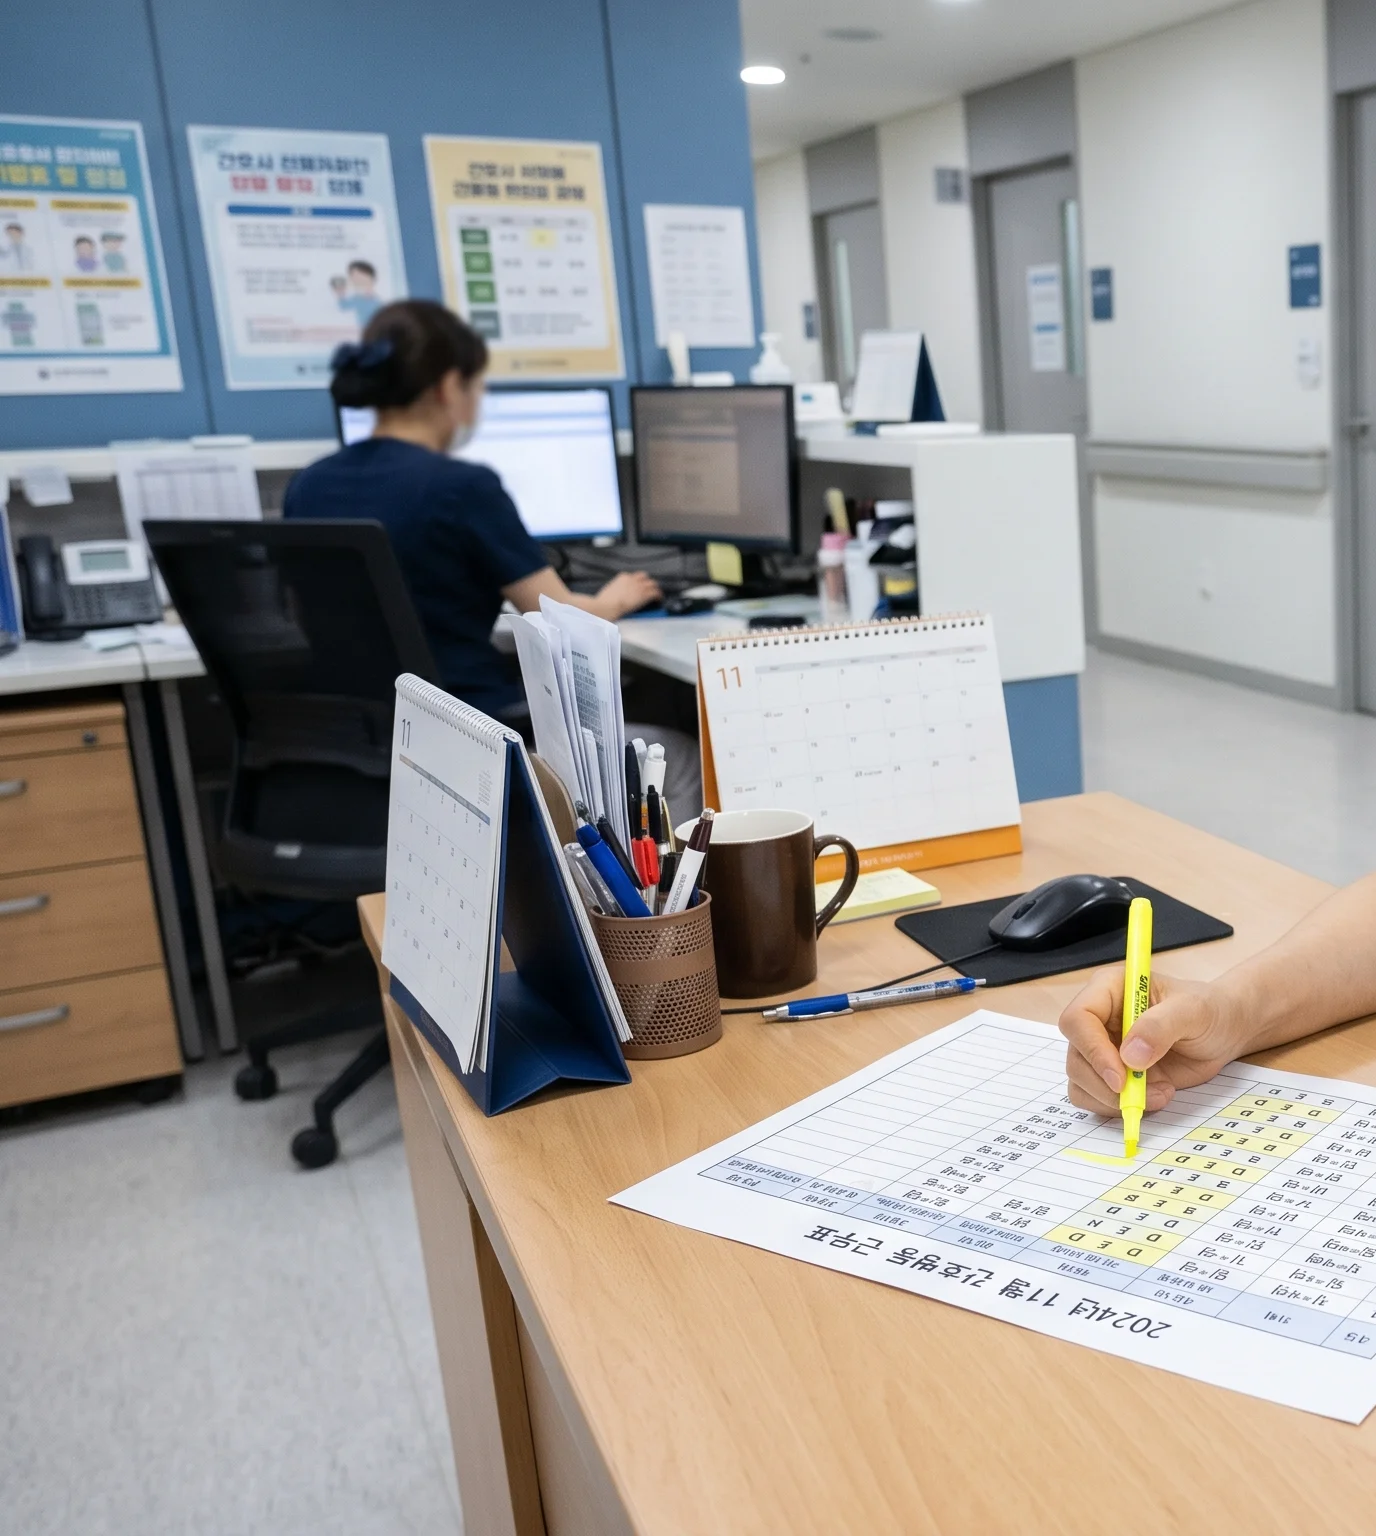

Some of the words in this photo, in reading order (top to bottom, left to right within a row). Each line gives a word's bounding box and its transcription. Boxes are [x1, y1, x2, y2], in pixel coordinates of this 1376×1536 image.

[717, 667, 741, 689] 11
[402, 719, 410, 748] 11
[1116, 1226, 1131, 1234] E
[1164, 1220, 1179, 1228] D
[804, 1221, 885, 1255] 근무표
[1069, 1233, 1085, 1241] D
[1146, 1234, 1162, 1242] D
[1127, 1248, 1142, 1257] D
[883, 1243, 997, 1291] 간호병동
[1068, 1294, 1174, 1338] 2024년
